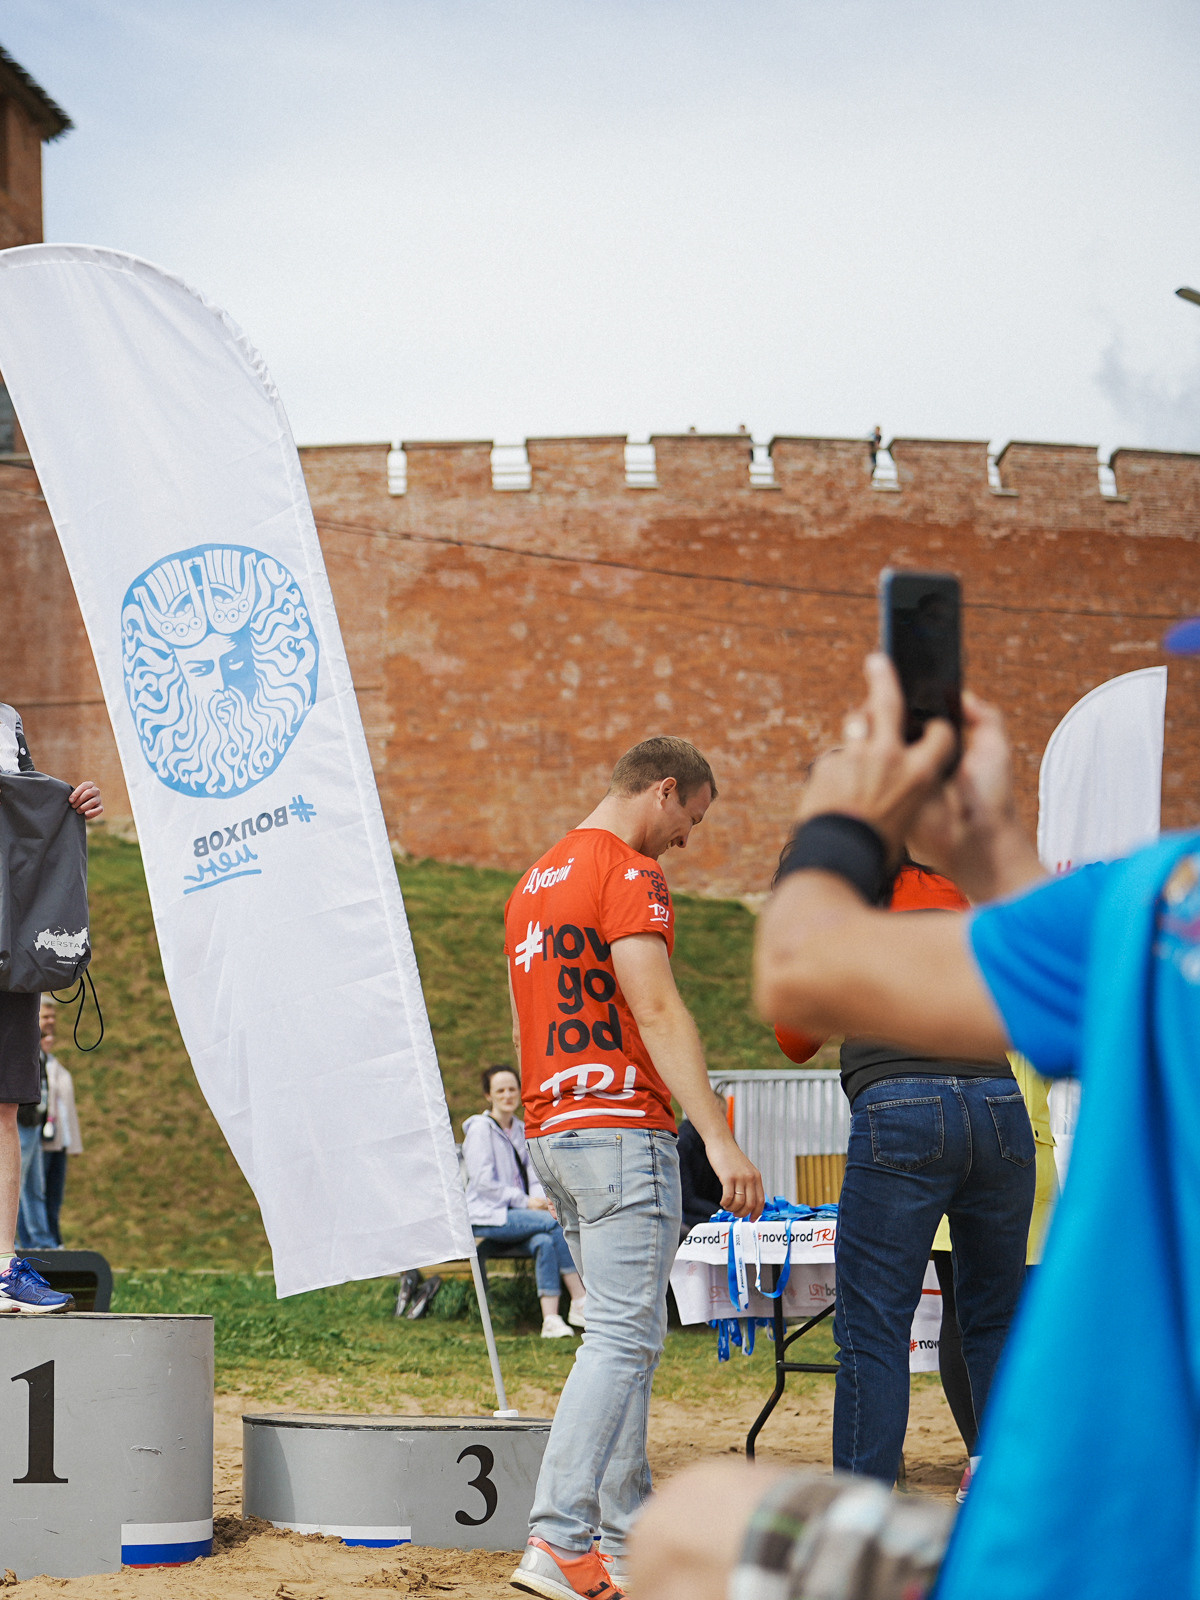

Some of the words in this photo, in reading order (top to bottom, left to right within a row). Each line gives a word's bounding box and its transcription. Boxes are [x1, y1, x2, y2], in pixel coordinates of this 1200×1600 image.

[43, 939, 81, 949] VERSTA
[514, 920, 611, 973] #nov
[557, 964, 617, 1015] go
[545, 1002, 623, 1057] rod
[10, 1359, 69, 1484] 1
[454, 1444, 498, 1526] 3
